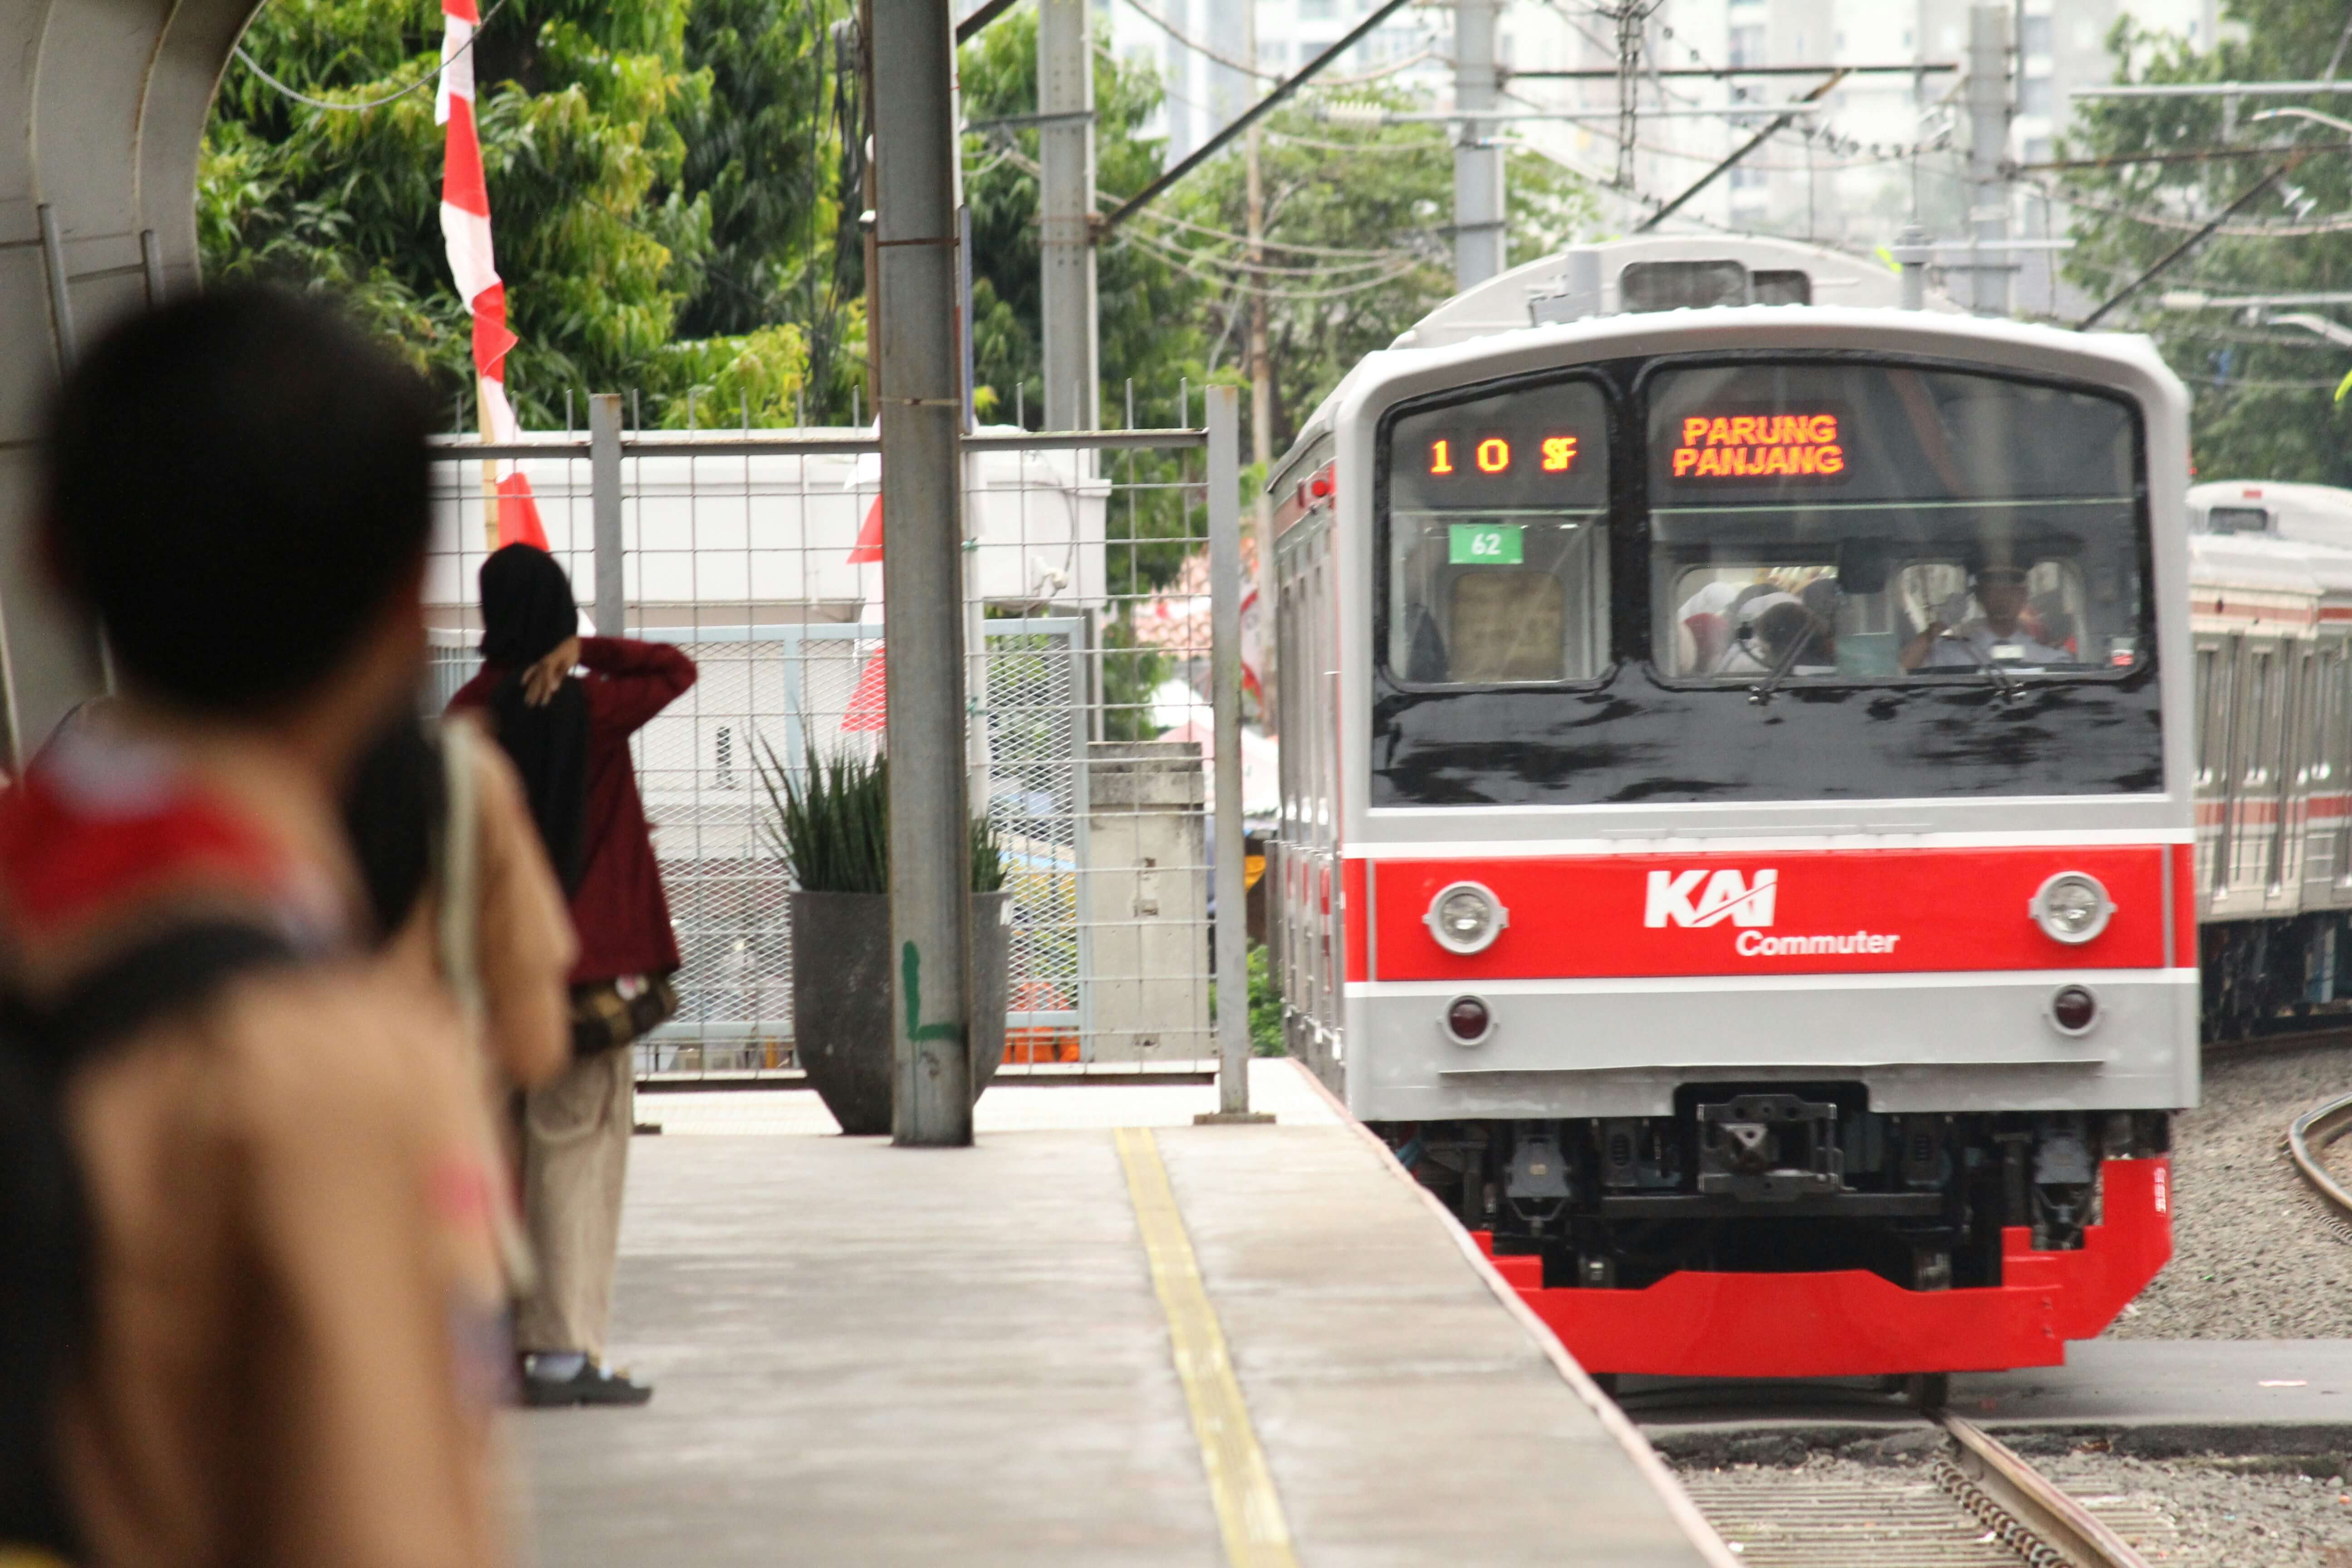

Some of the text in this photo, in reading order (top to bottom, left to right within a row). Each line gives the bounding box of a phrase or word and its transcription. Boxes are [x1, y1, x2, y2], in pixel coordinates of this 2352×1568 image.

[1683, 414, 1837, 446] PARUNG
[1673, 445, 1844, 476] PANJANG
[1471, 533, 1502, 555] 62
[1644, 869, 1778, 928] KAI
[1735, 930, 1900, 956] Commuter
